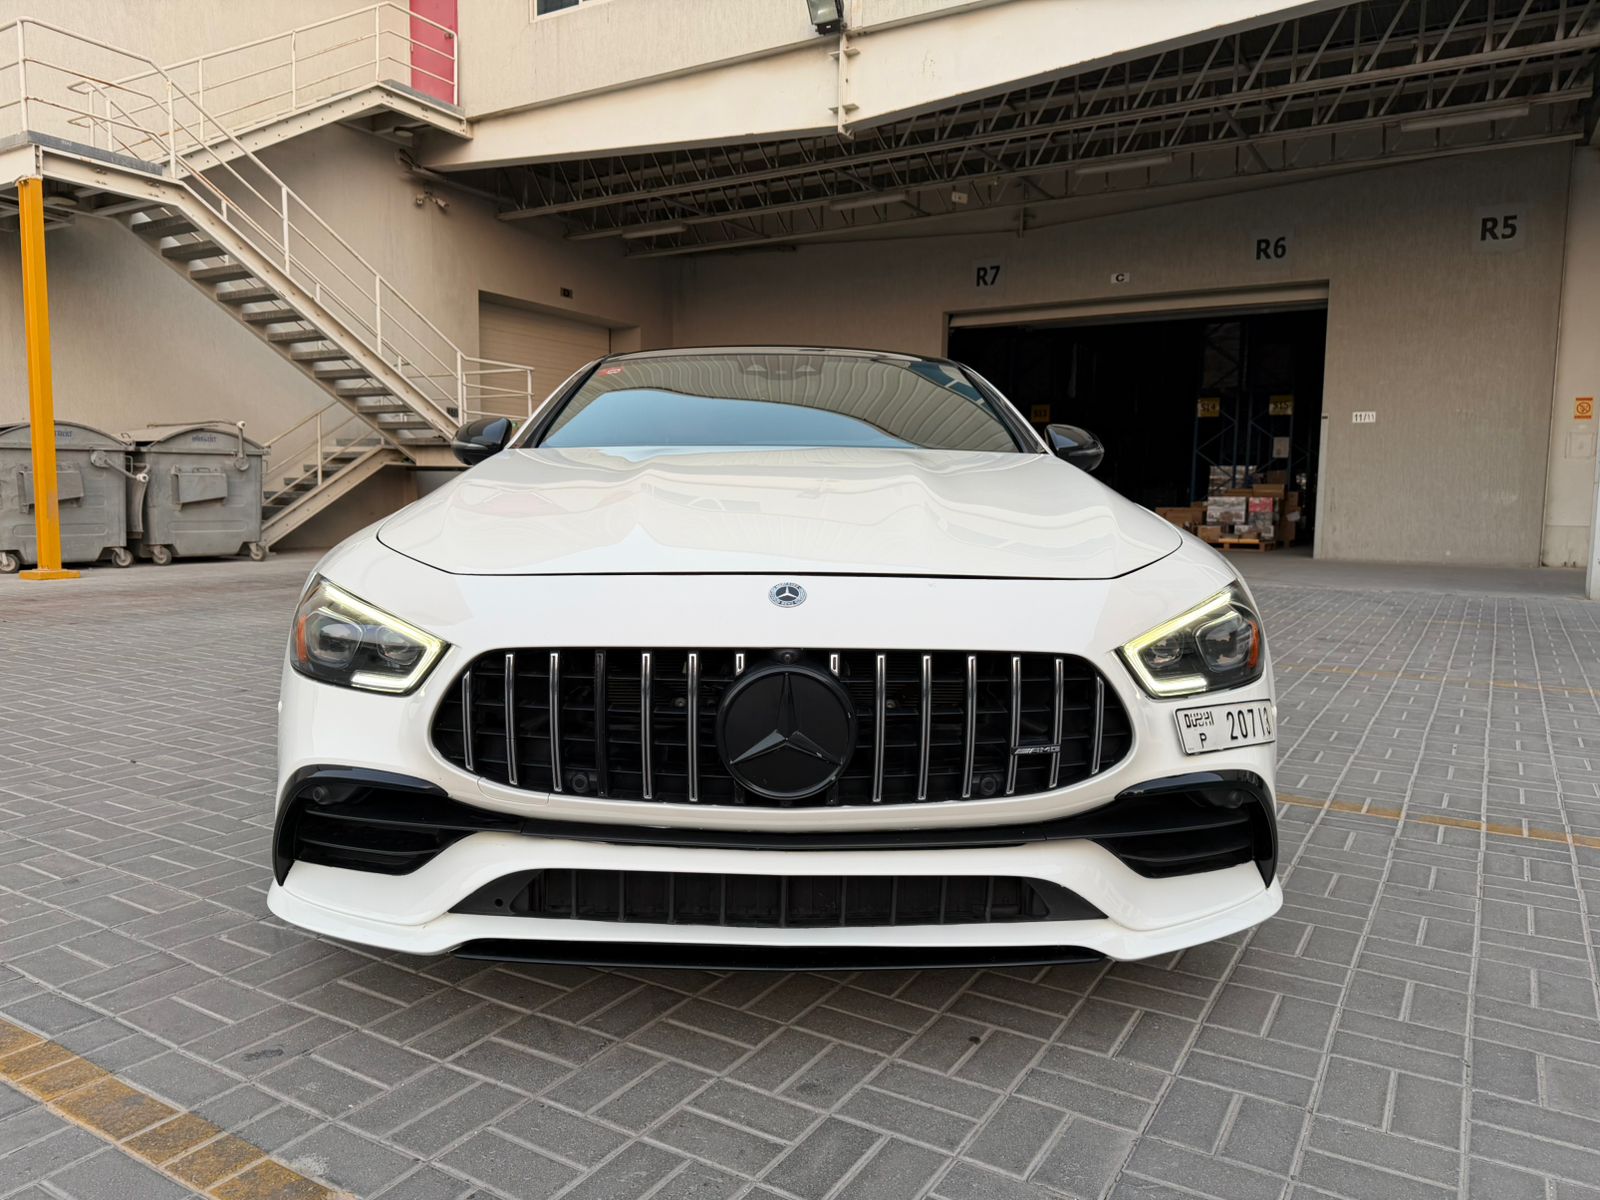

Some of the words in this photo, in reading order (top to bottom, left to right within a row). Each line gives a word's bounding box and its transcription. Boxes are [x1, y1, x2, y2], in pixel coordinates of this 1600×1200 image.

[1480, 215, 1518, 241] R5
[1256, 236, 1286, 260] R6
[976, 265, 1001, 287] R7
[1115, 273, 1125, 283] C
[1226, 706, 1271, 740] 20713
[1199, 732, 1207, 748] P
